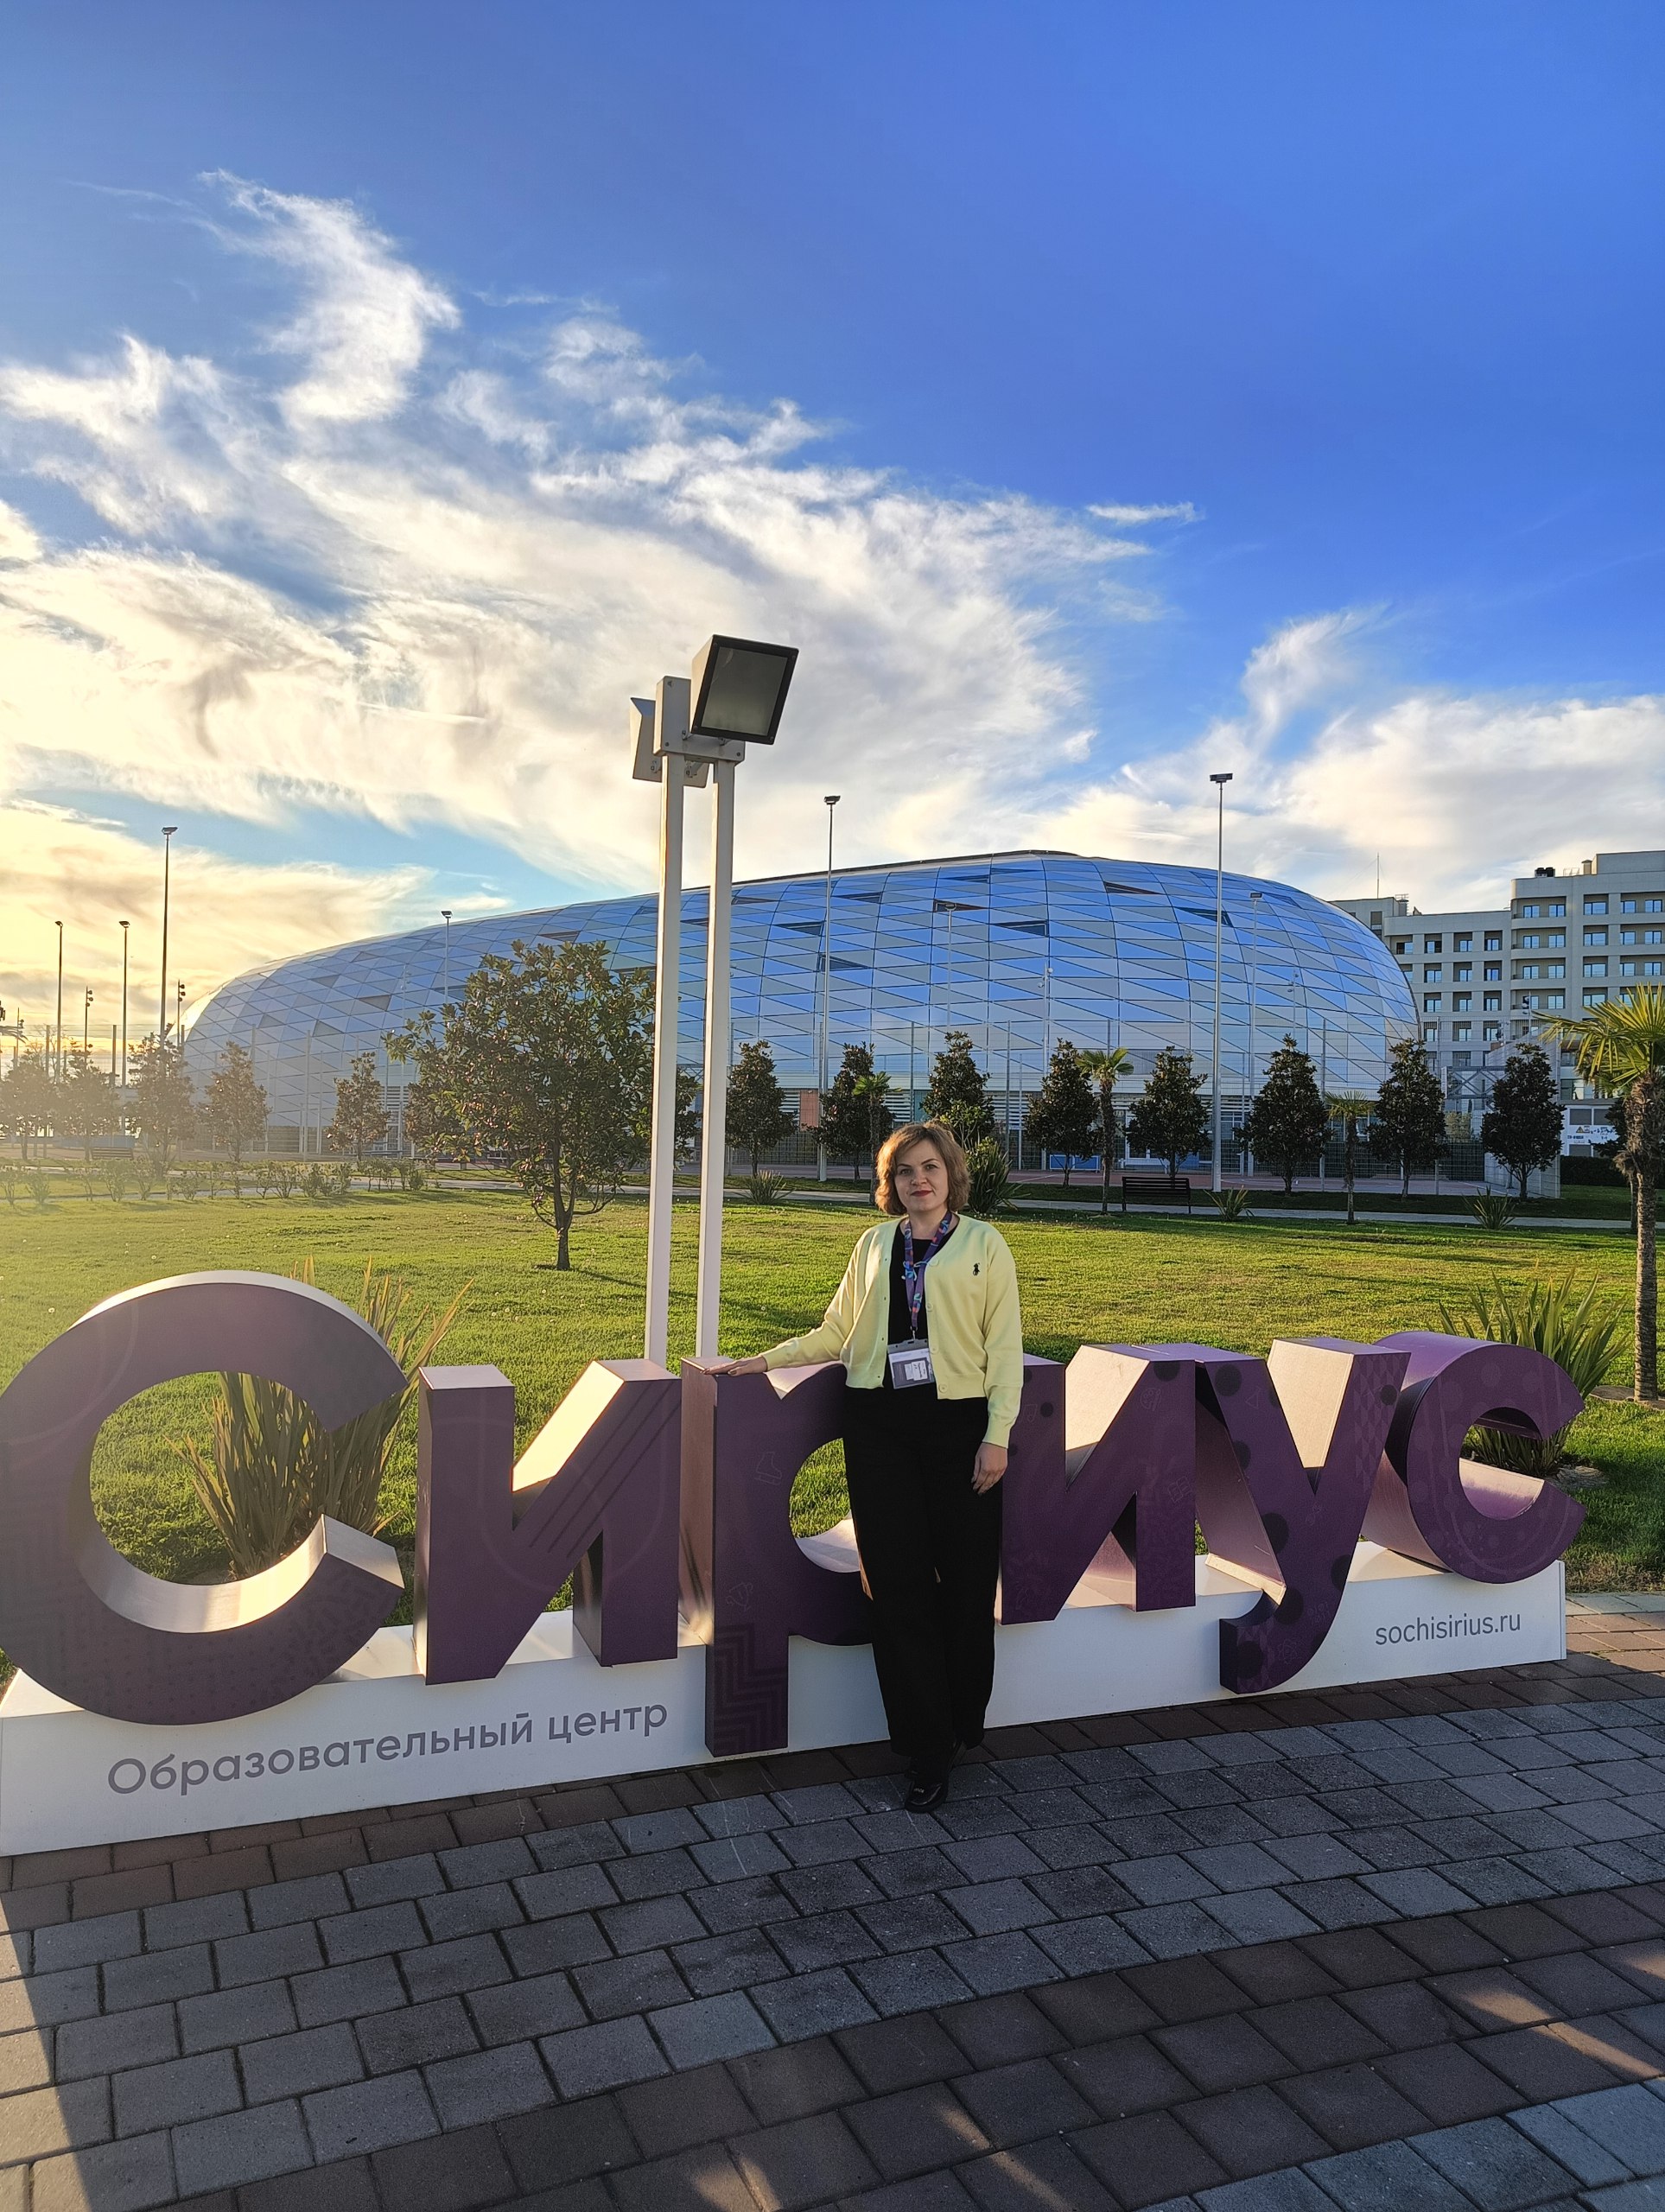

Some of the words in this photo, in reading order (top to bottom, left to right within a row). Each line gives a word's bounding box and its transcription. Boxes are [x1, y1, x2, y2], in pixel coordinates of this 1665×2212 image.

[0, 1272, 1586, 1756] Сириус
[1375, 1612, 1521, 1646] sochisirius.ru
[108, 1713, 532, 1796] Образовательный
[549, 1704, 668, 1744] центр
